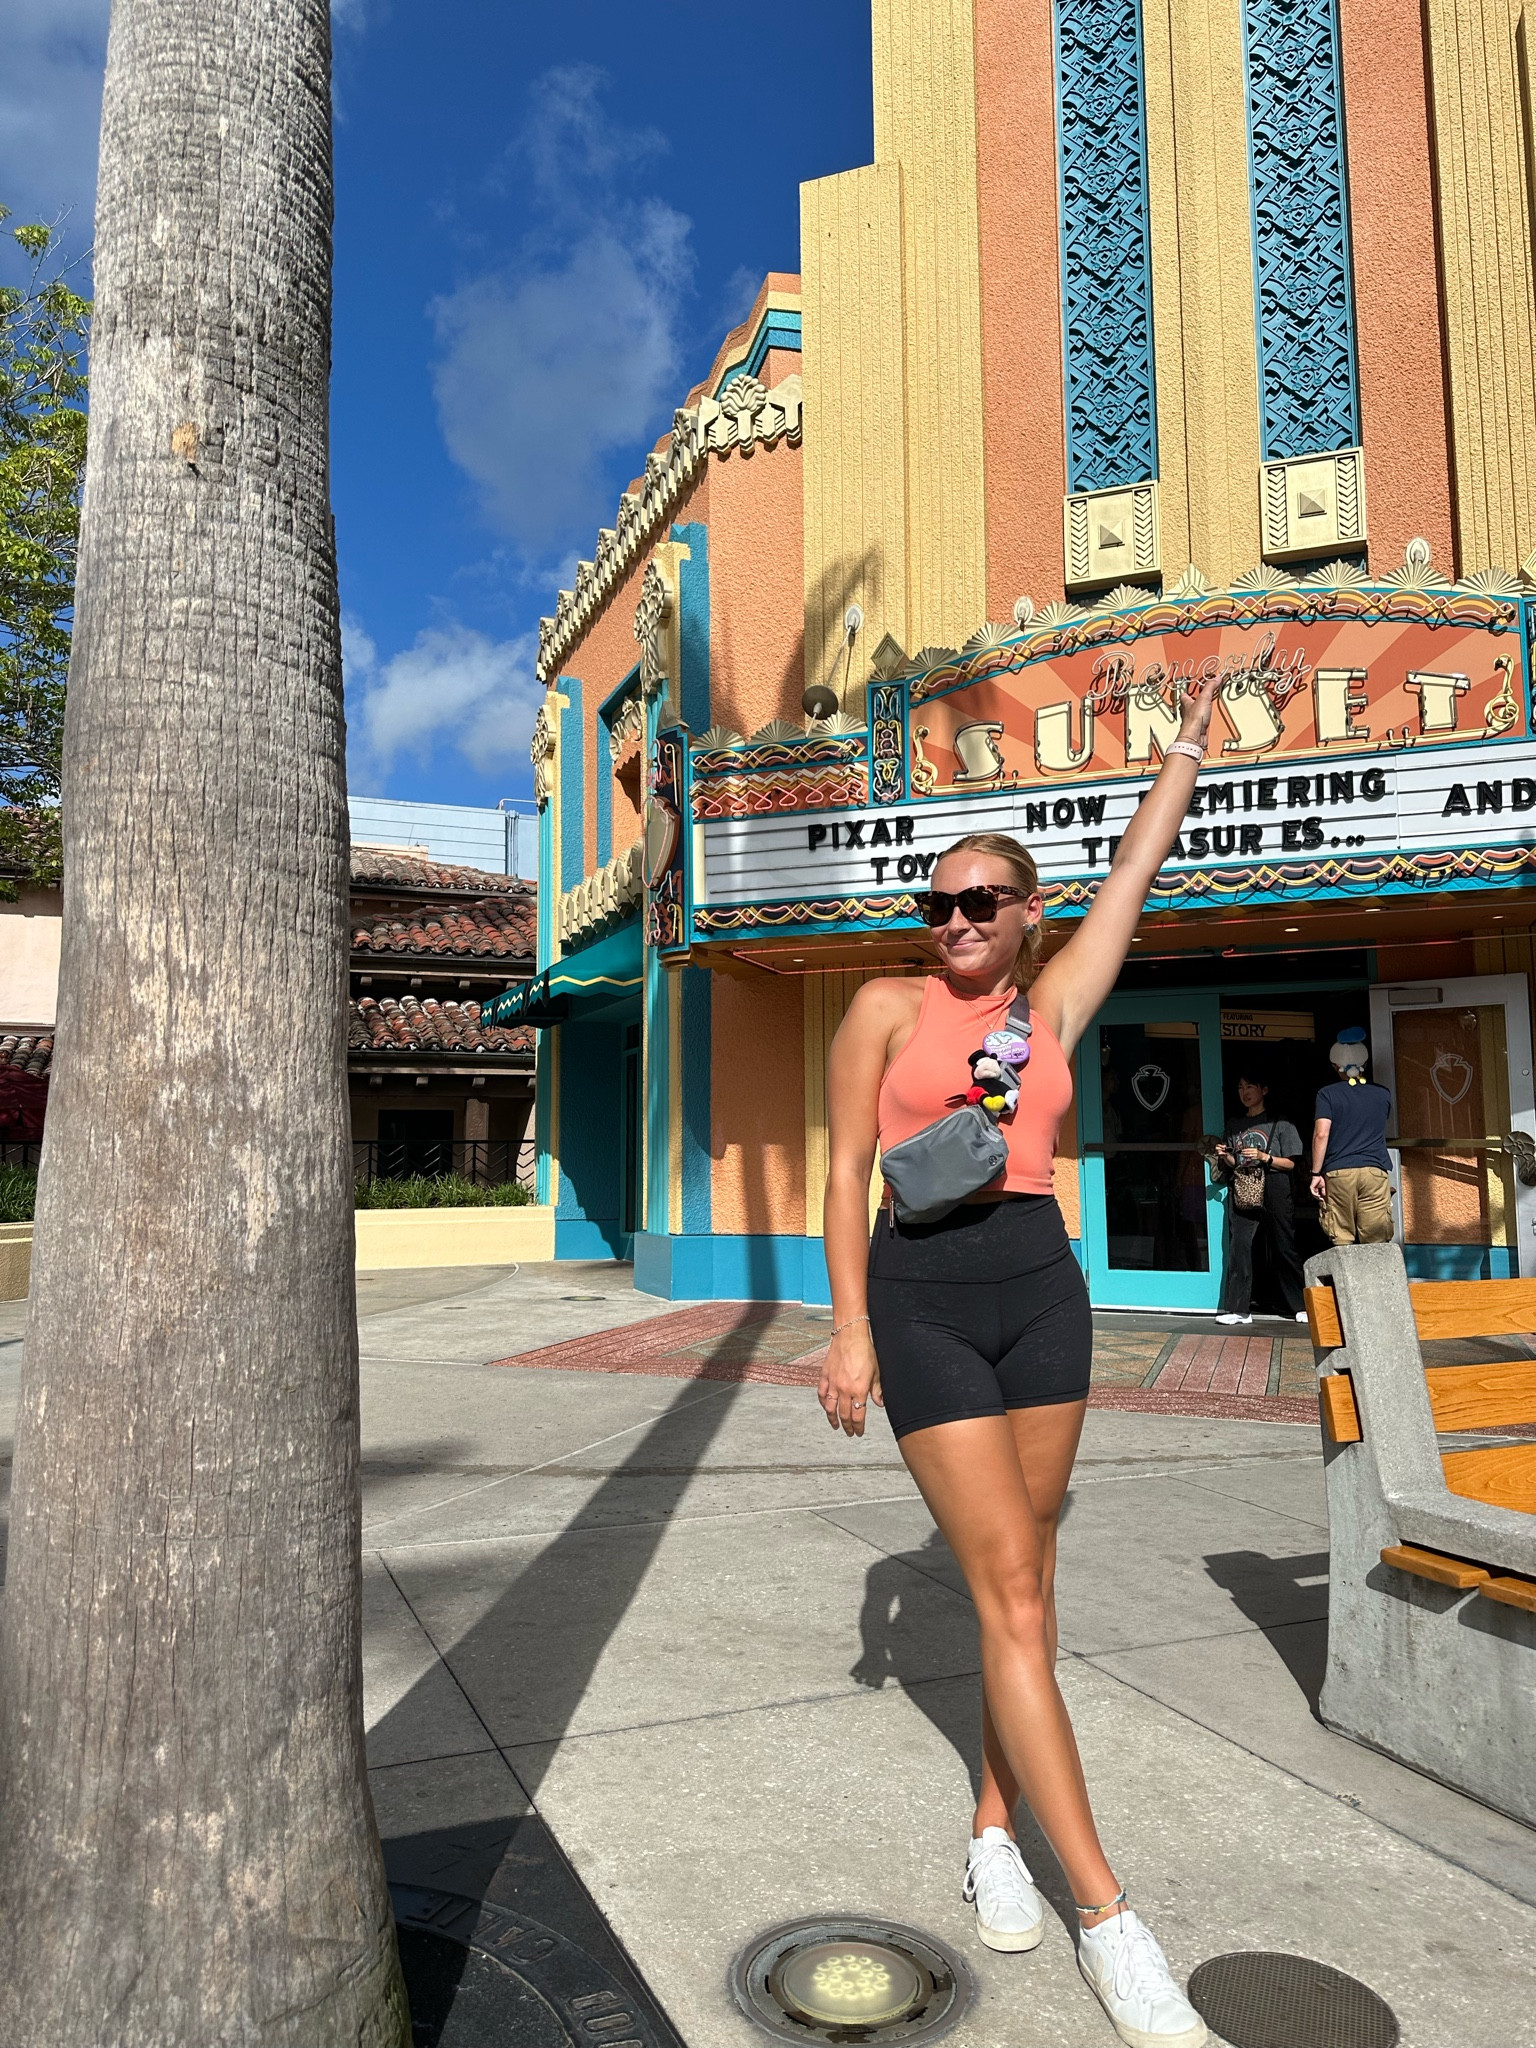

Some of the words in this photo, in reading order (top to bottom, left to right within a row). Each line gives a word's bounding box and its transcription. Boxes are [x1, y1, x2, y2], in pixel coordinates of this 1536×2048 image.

[1087, 631, 1312, 701] Beverly
[953, 667, 1471, 781] SUNSET
[808, 815, 914, 851] PIXAR
[1026, 795, 1106, 833] NOW
[1138, 767, 1386, 822] EMIERING
[1442, 777, 1536, 818] AND
[1223, 1013, 1253, 1021] FEATURING
[1223, 1024, 1266, 1037] STORY
